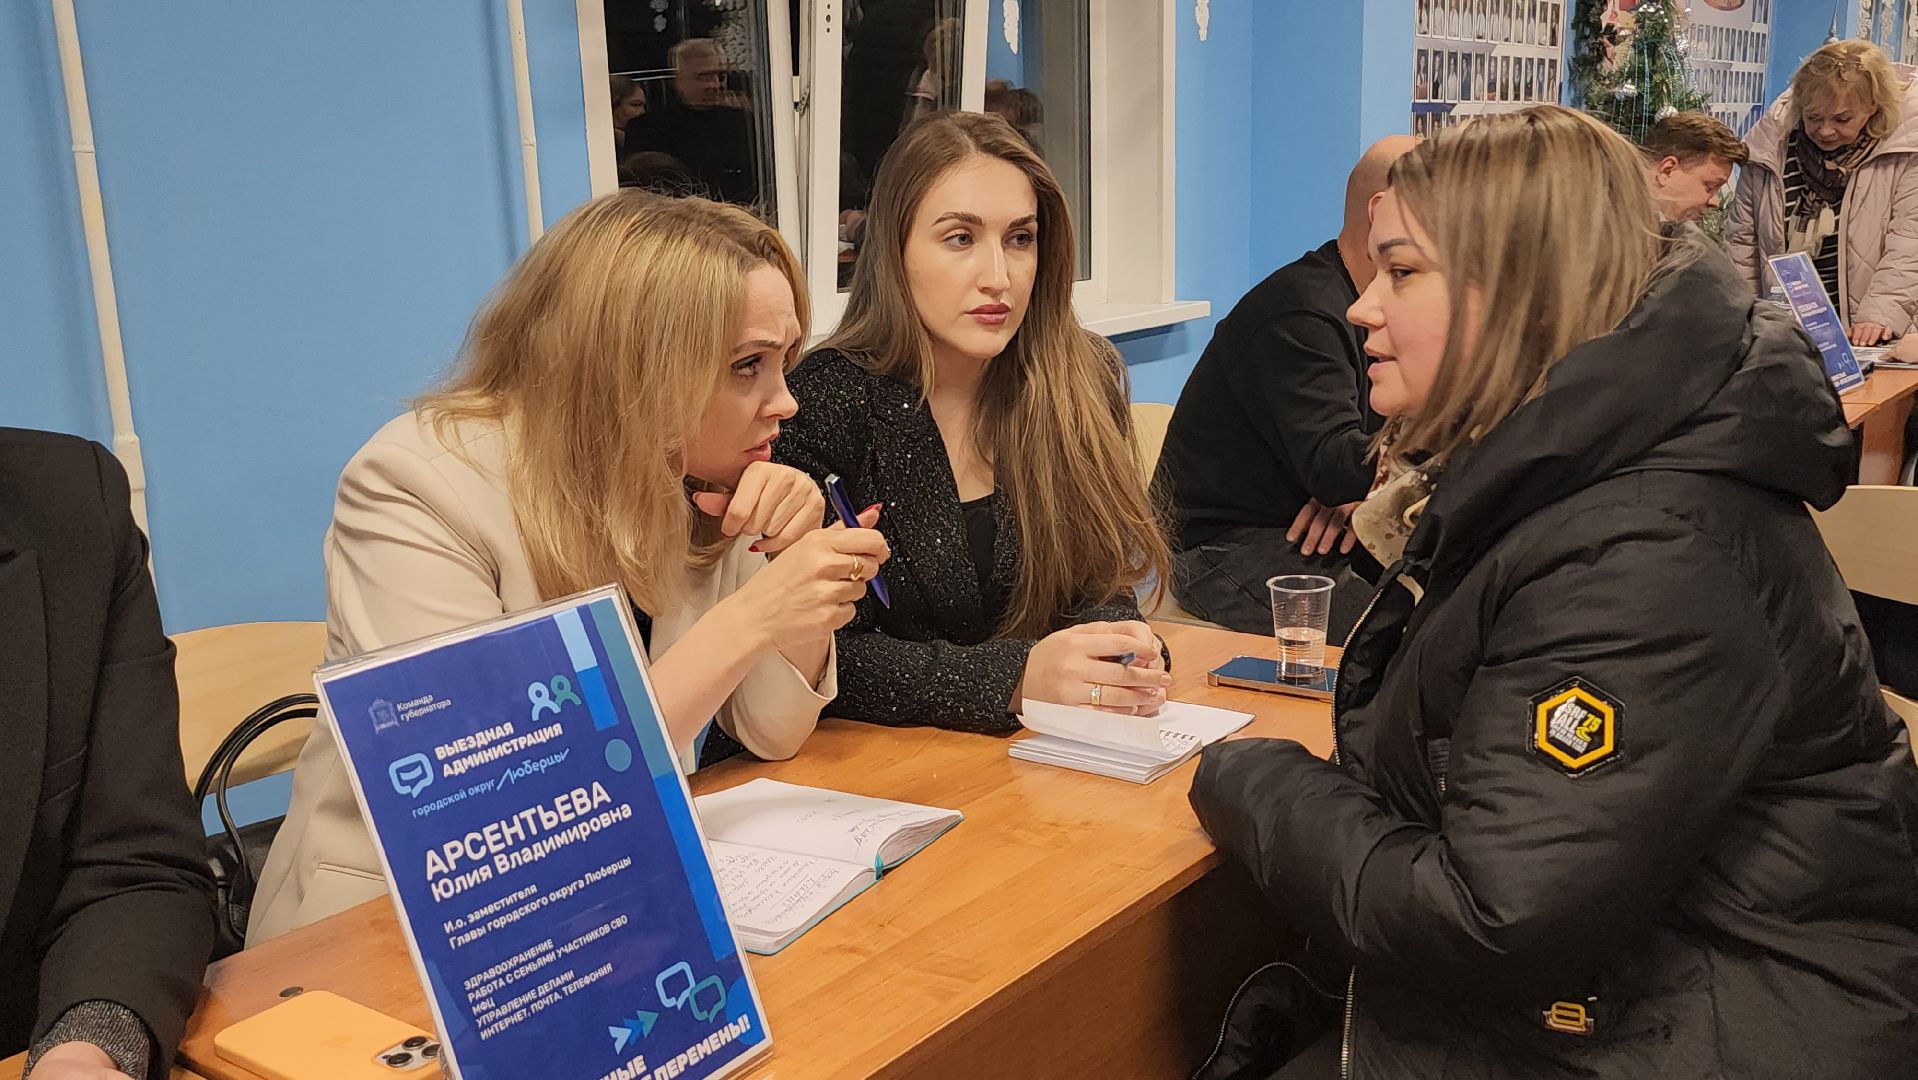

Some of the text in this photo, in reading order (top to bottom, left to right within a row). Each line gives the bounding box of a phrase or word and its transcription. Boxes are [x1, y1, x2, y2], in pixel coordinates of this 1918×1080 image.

[396, 694, 434, 712] Команда
[400, 699, 452, 721] губернатора
[434, 722, 515, 760] ВЫЕЗДНАЯ
[442, 722, 563, 778] АДМИНИСТРАЦИЯ
[411, 748, 570, 818] городской округ Люберцы
[426, 781, 612, 881] АРСЕНТЬЕВА
[430, 803, 633, 903] Юлия Владимировна
[443, 883, 538, 935] И.о. заместителя
[449, 856, 632, 950] Главы городского округа Люберцы
[463, 938, 554, 991] ЗДРАВООХРАНЕНИЕ
[467, 914, 629, 1004] РАБОТА С СЕМЬЯМИ УЧАСТНИКОВ СВО
[472, 997, 496, 1016] МФЦ
[476, 969, 575, 1028] УПРАВЛЕНИЕ ДЕЛАМИ
[480, 1007, 532, 1041] ИНТЕРНЕТ,
[562, 962, 613, 996] ТЕЛЕФОНИЯ
[653, 1013, 751, 1080] ПЕРЕМЕНЫ!
